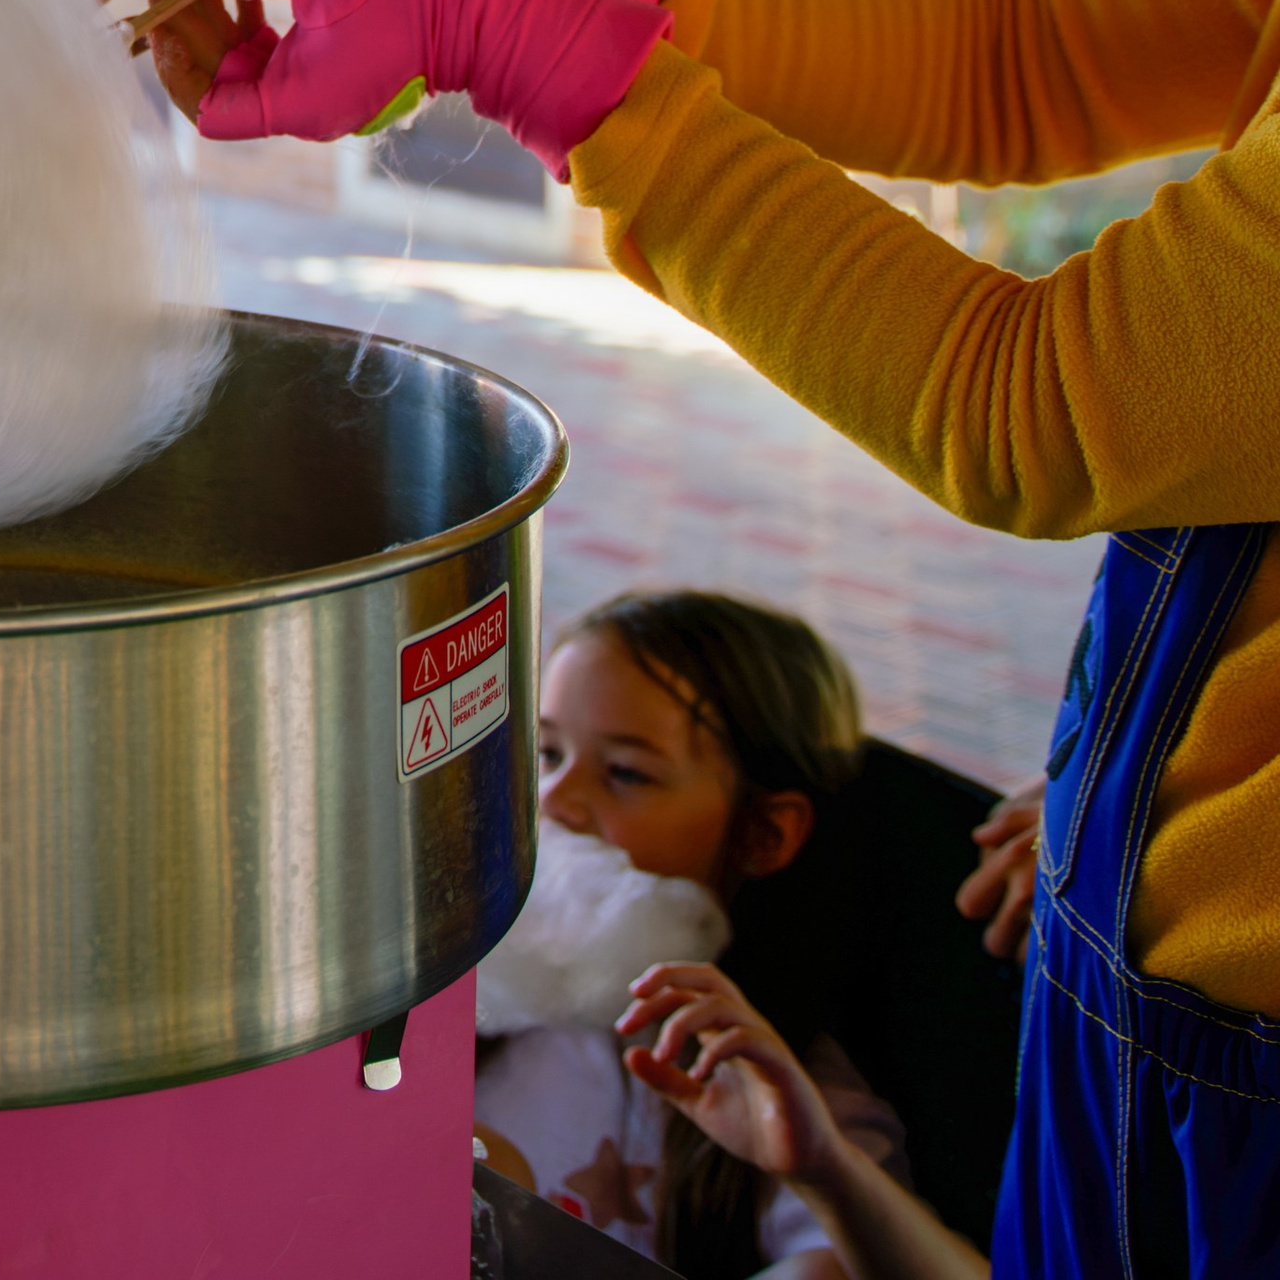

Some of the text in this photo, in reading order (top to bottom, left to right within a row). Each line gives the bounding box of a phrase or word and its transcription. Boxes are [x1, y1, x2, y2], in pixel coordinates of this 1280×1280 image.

[447, 610, 502, 672] DANGER
[453, 673, 497, 712] ELECTRIC SHOCK
[453, 682, 504, 727] OPERATE CAREFULLY
